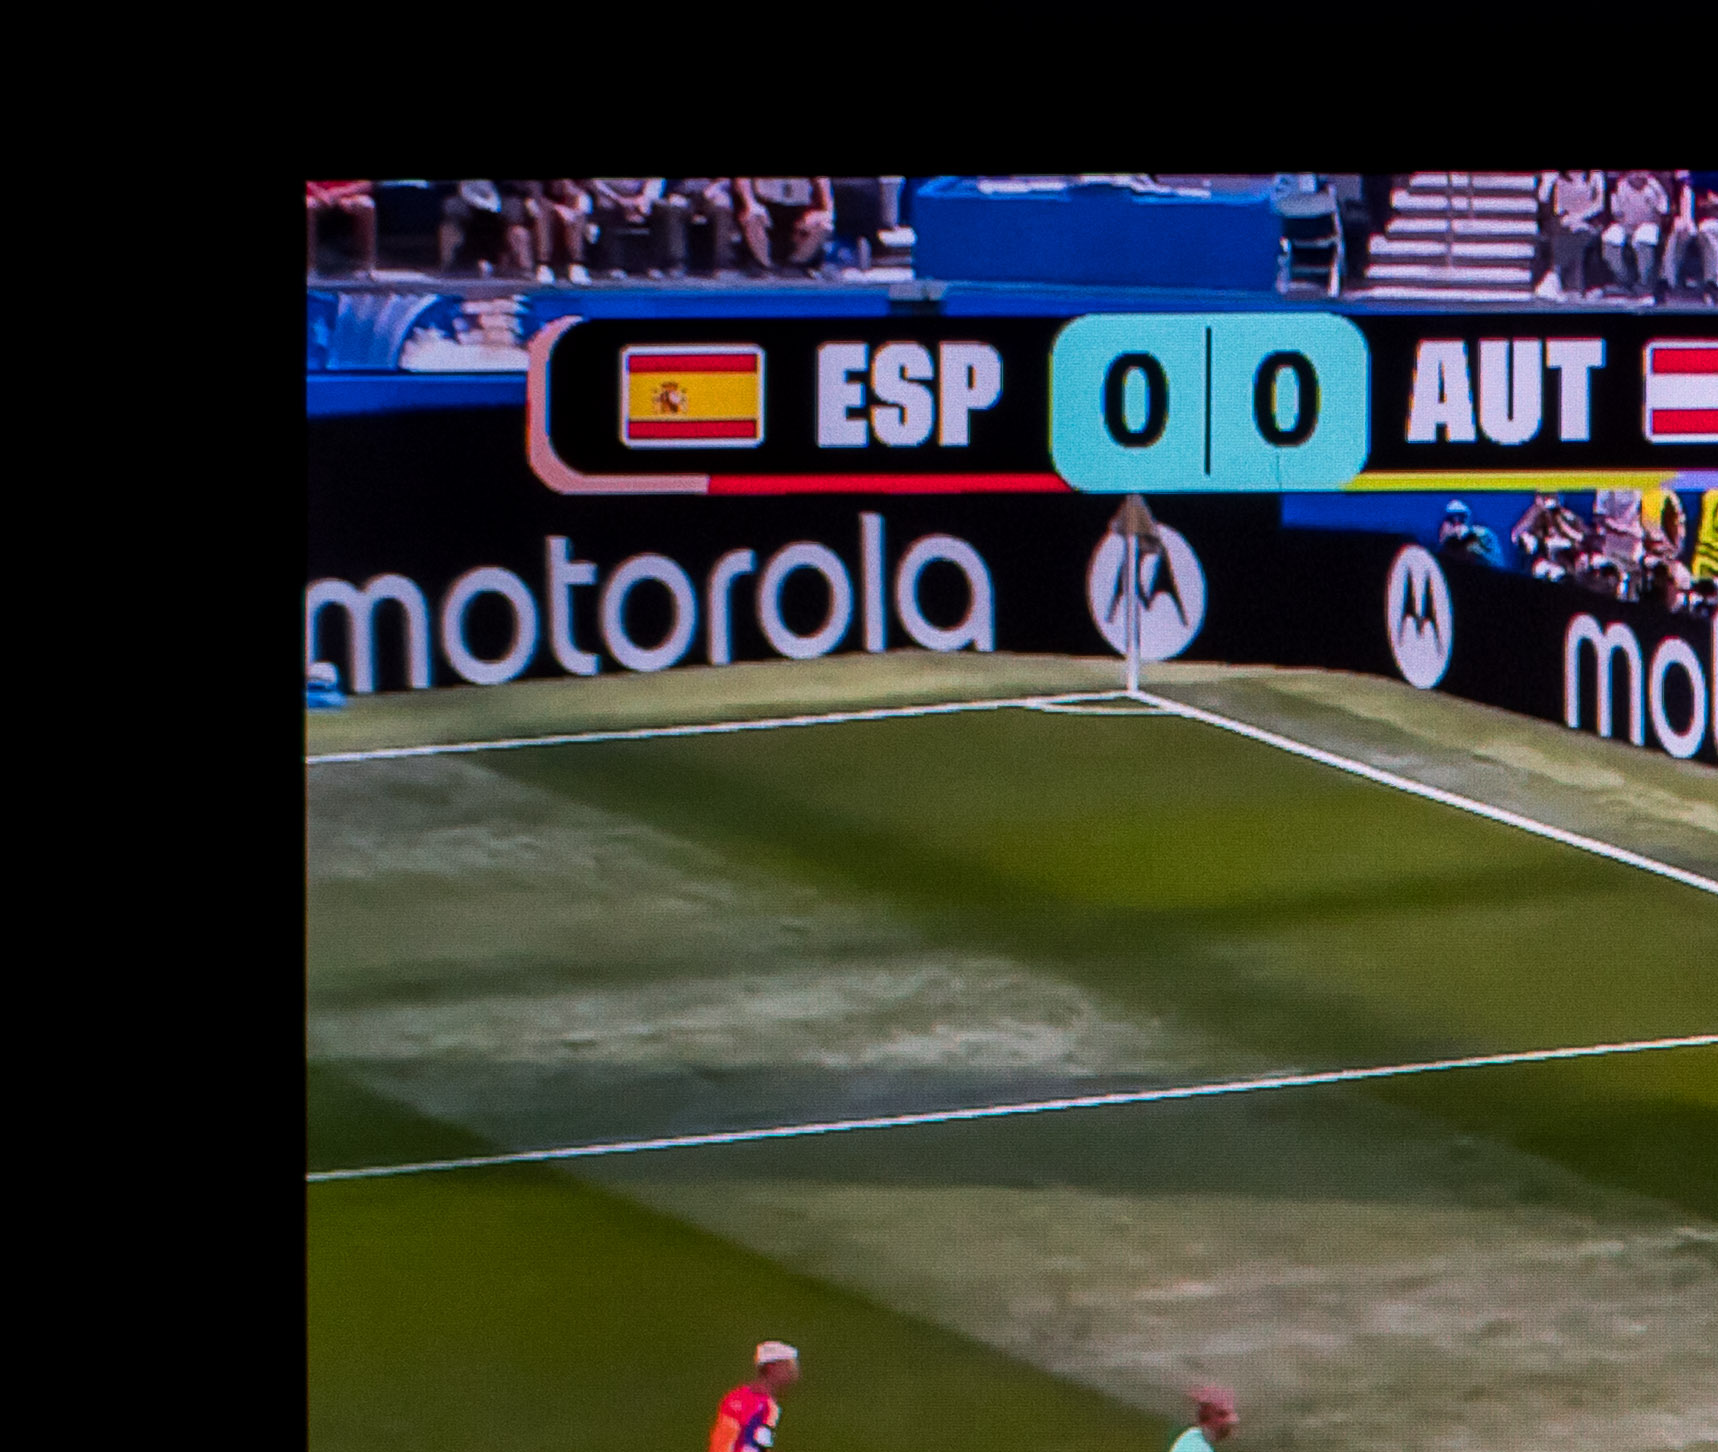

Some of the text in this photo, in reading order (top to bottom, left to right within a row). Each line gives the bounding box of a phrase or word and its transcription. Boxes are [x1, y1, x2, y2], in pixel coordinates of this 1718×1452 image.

[816, 338, 1607, 448] ESP 0 0 AUT
[305, 511, 997, 693] motorola
